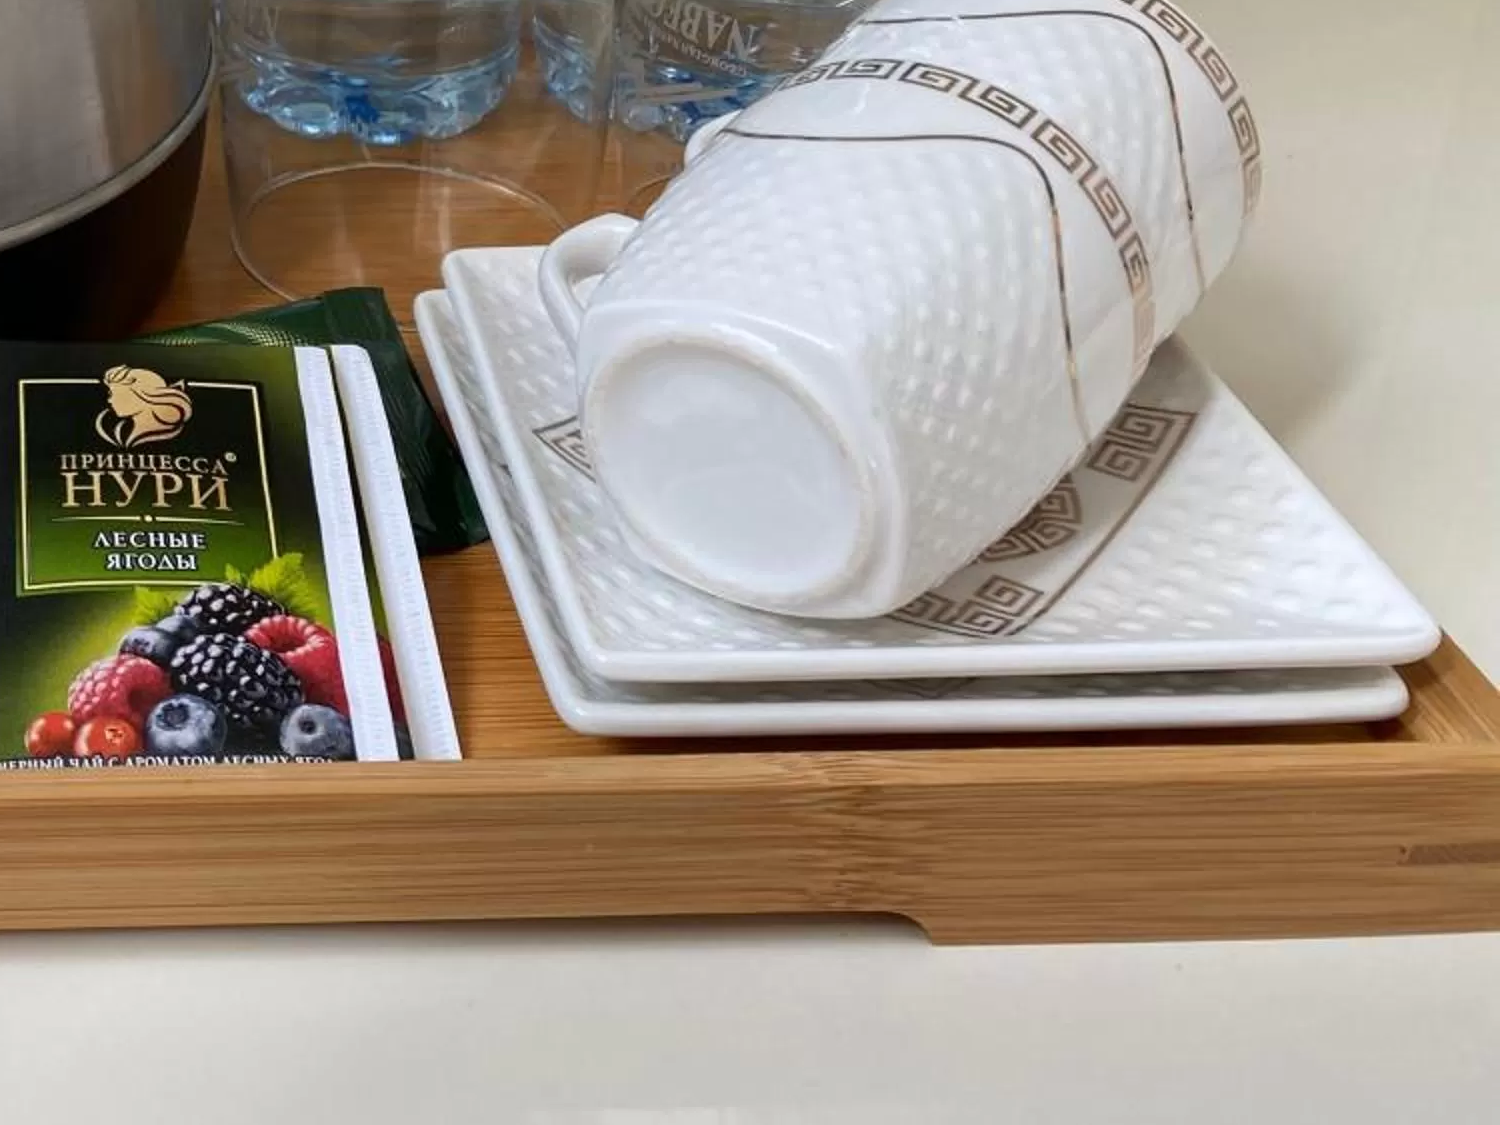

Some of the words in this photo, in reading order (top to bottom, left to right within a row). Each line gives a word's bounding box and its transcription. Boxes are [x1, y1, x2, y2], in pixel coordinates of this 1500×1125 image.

[60, 453, 229, 475] ПРИНЦЕССА
[61, 472, 234, 512] НУРИ
[93, 530, 207, 550] ЛЕСНЫЕ
[106, 552, 197, 572] ЯГОДЫ
